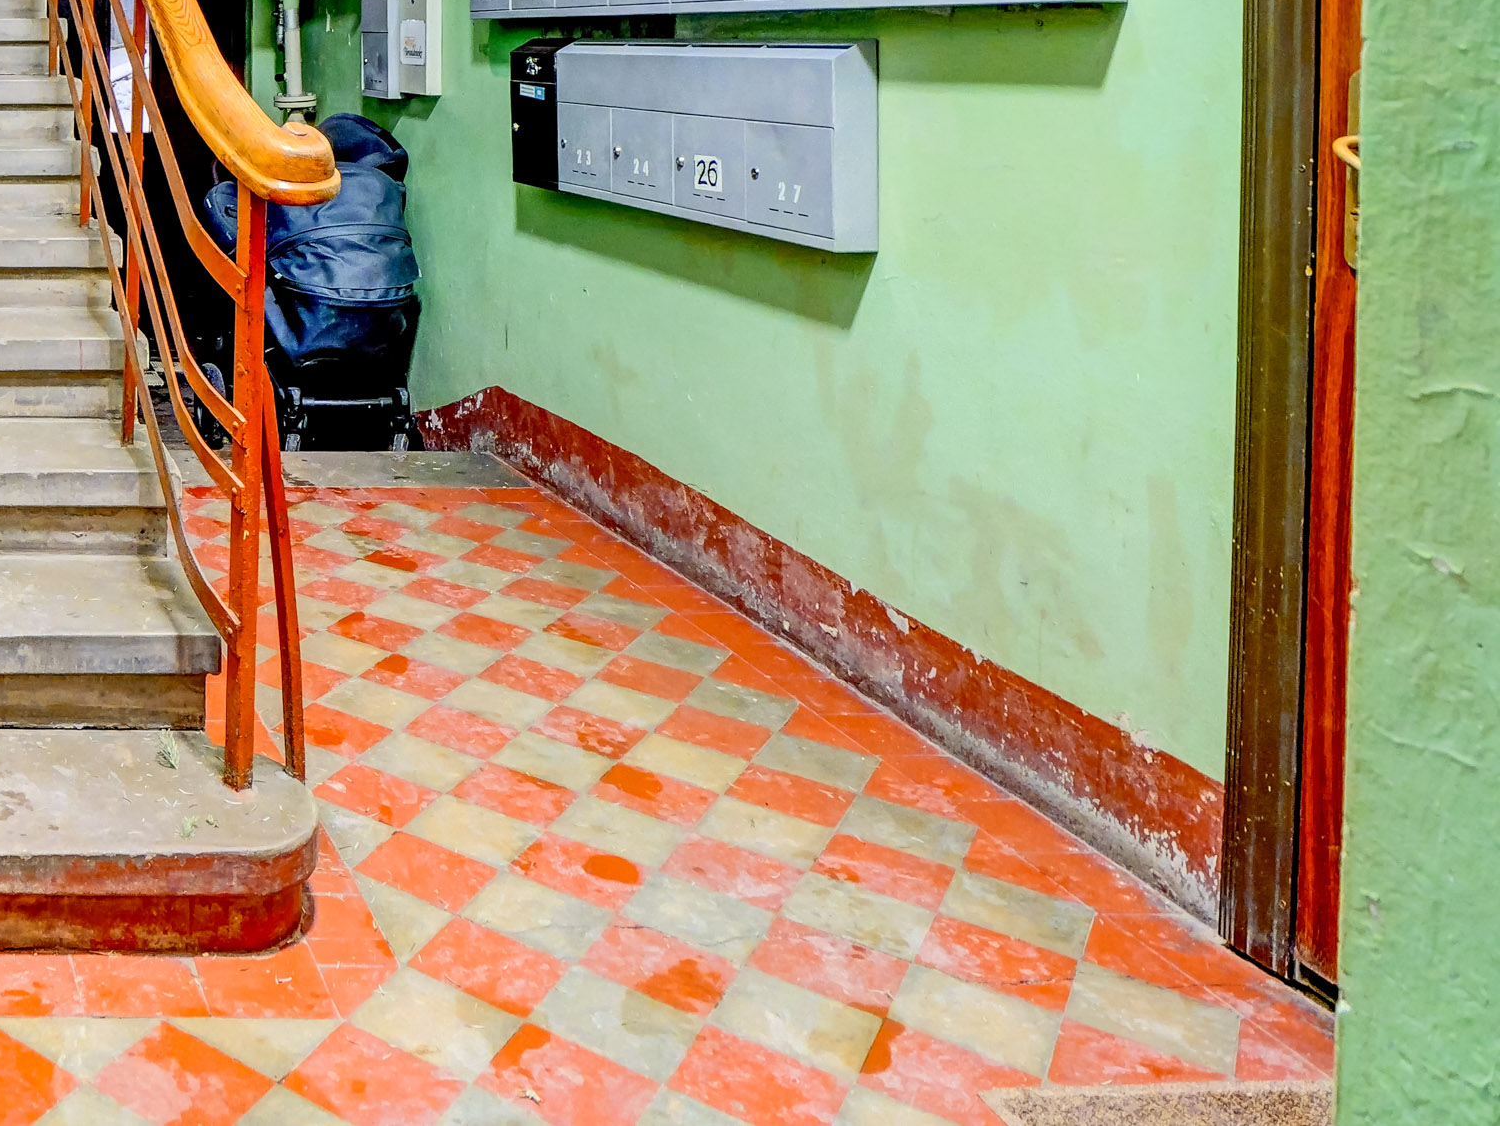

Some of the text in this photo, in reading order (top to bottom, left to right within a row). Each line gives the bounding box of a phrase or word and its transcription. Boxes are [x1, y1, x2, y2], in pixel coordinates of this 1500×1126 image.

[576, 148, 592, 166] 23
[632, 158, 649, 177] 24
[695, 158, 719, 188] 26
[777, 180, 802, 205] 27
